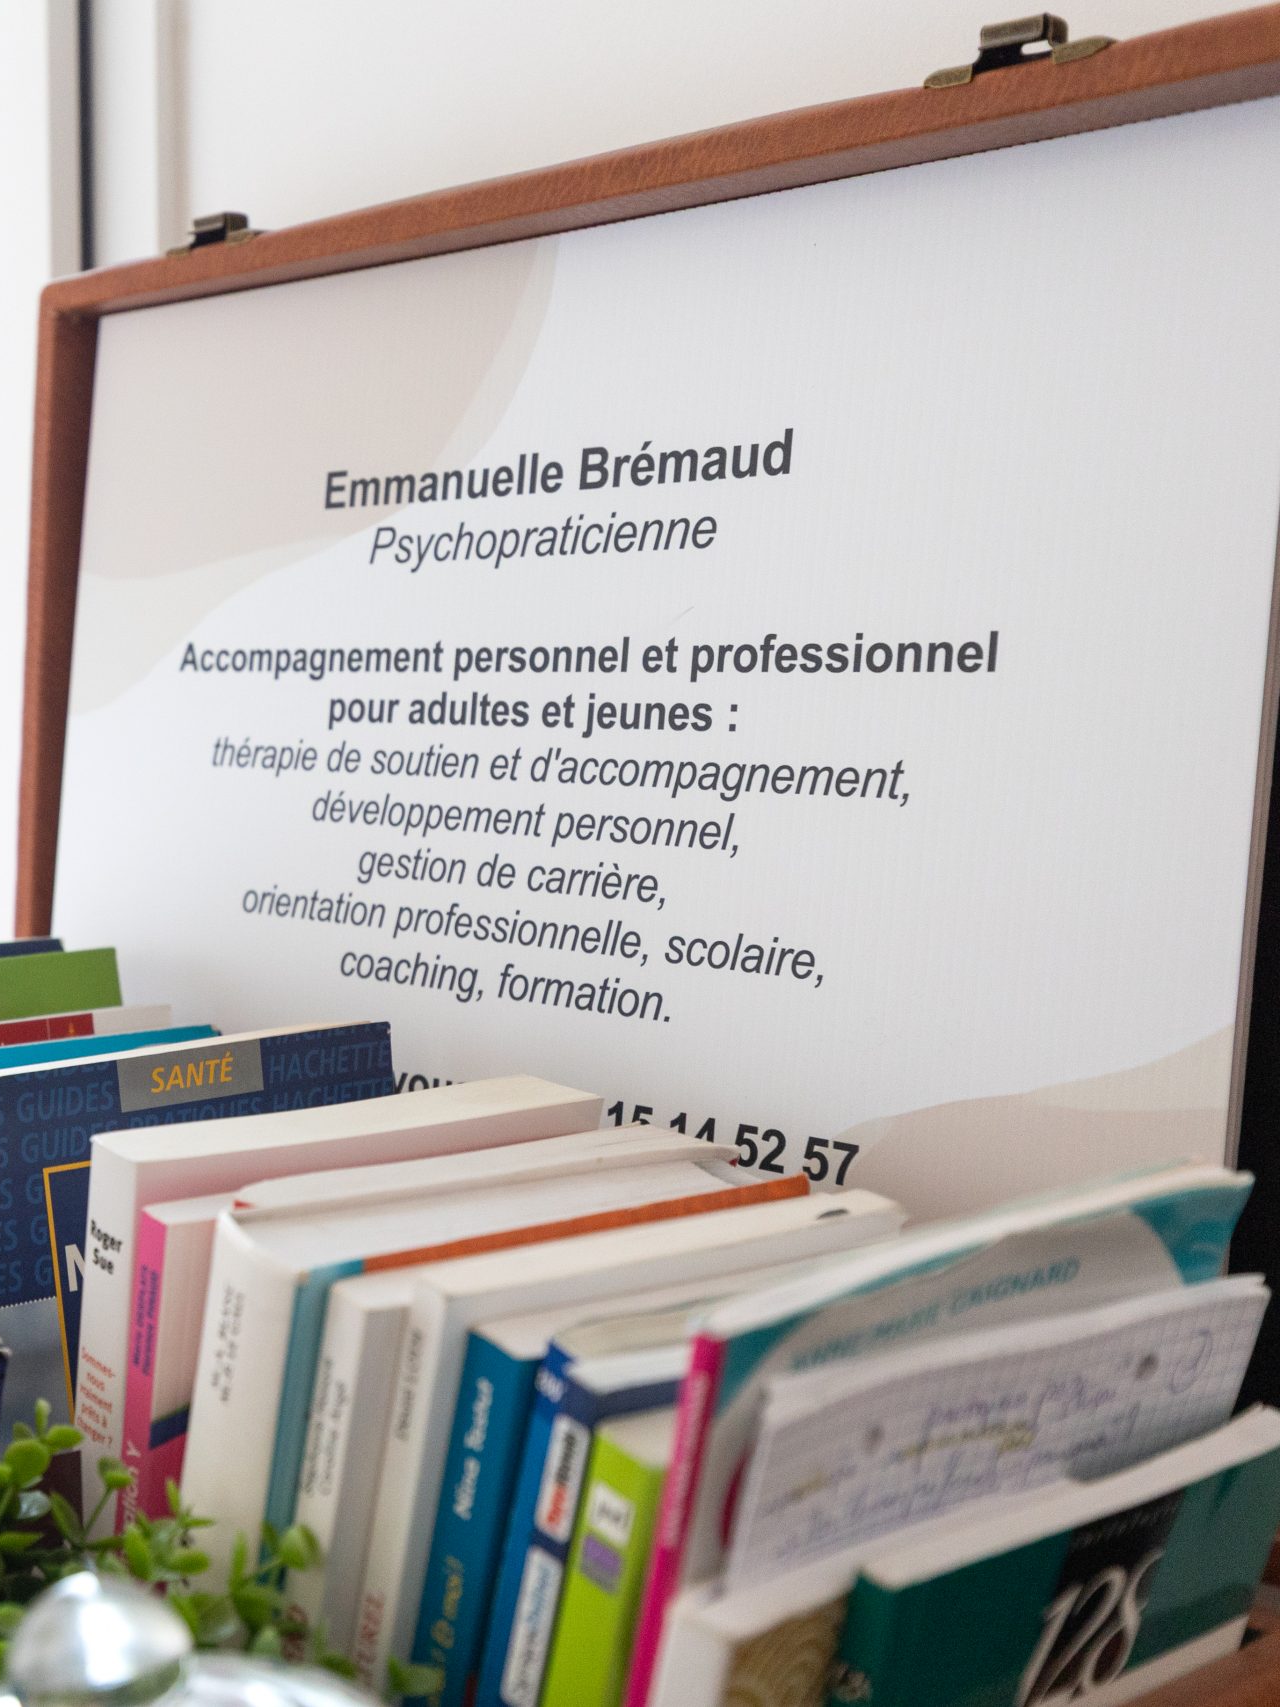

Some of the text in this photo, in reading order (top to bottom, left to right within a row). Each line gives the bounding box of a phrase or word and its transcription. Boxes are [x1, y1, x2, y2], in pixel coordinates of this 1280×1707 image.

[323, 428, 794, 511] Emmanuelle Brémaud
[370, 512, 718, 572] Psychopraticienne
[180, 631, 999, 683] Accompagnement personnel et professionnel
[328, 698, 400, 730] pour
[408, 692, 530, 728] adultes
[541, 695, 575, 729] et
[582, 697, 714, 736] jeunes
[211, 738, 912, 806] thérapie de soutien et d'accompagnement,
[312, 790, 741, 857] développement personnel,
[357, 848, 667, 911] gestion de carrière,
[242, 885, 826, 988] orientation professionnelle, scolaire,
[339, 948, 673, 1023] coaching, formation.
[150, 1050, 235, 1094] SANTÉ
[270, 1038, 392, 1086] HACHETTE
[16, 1080, 115, 1124] GUIDES
[734, 1123, 787, 1174] 52
[802, 1136, 860, 1186] 57
[89, 1220, 124, 1253] Roger
[93, 1248, 116, 1276] Sue
